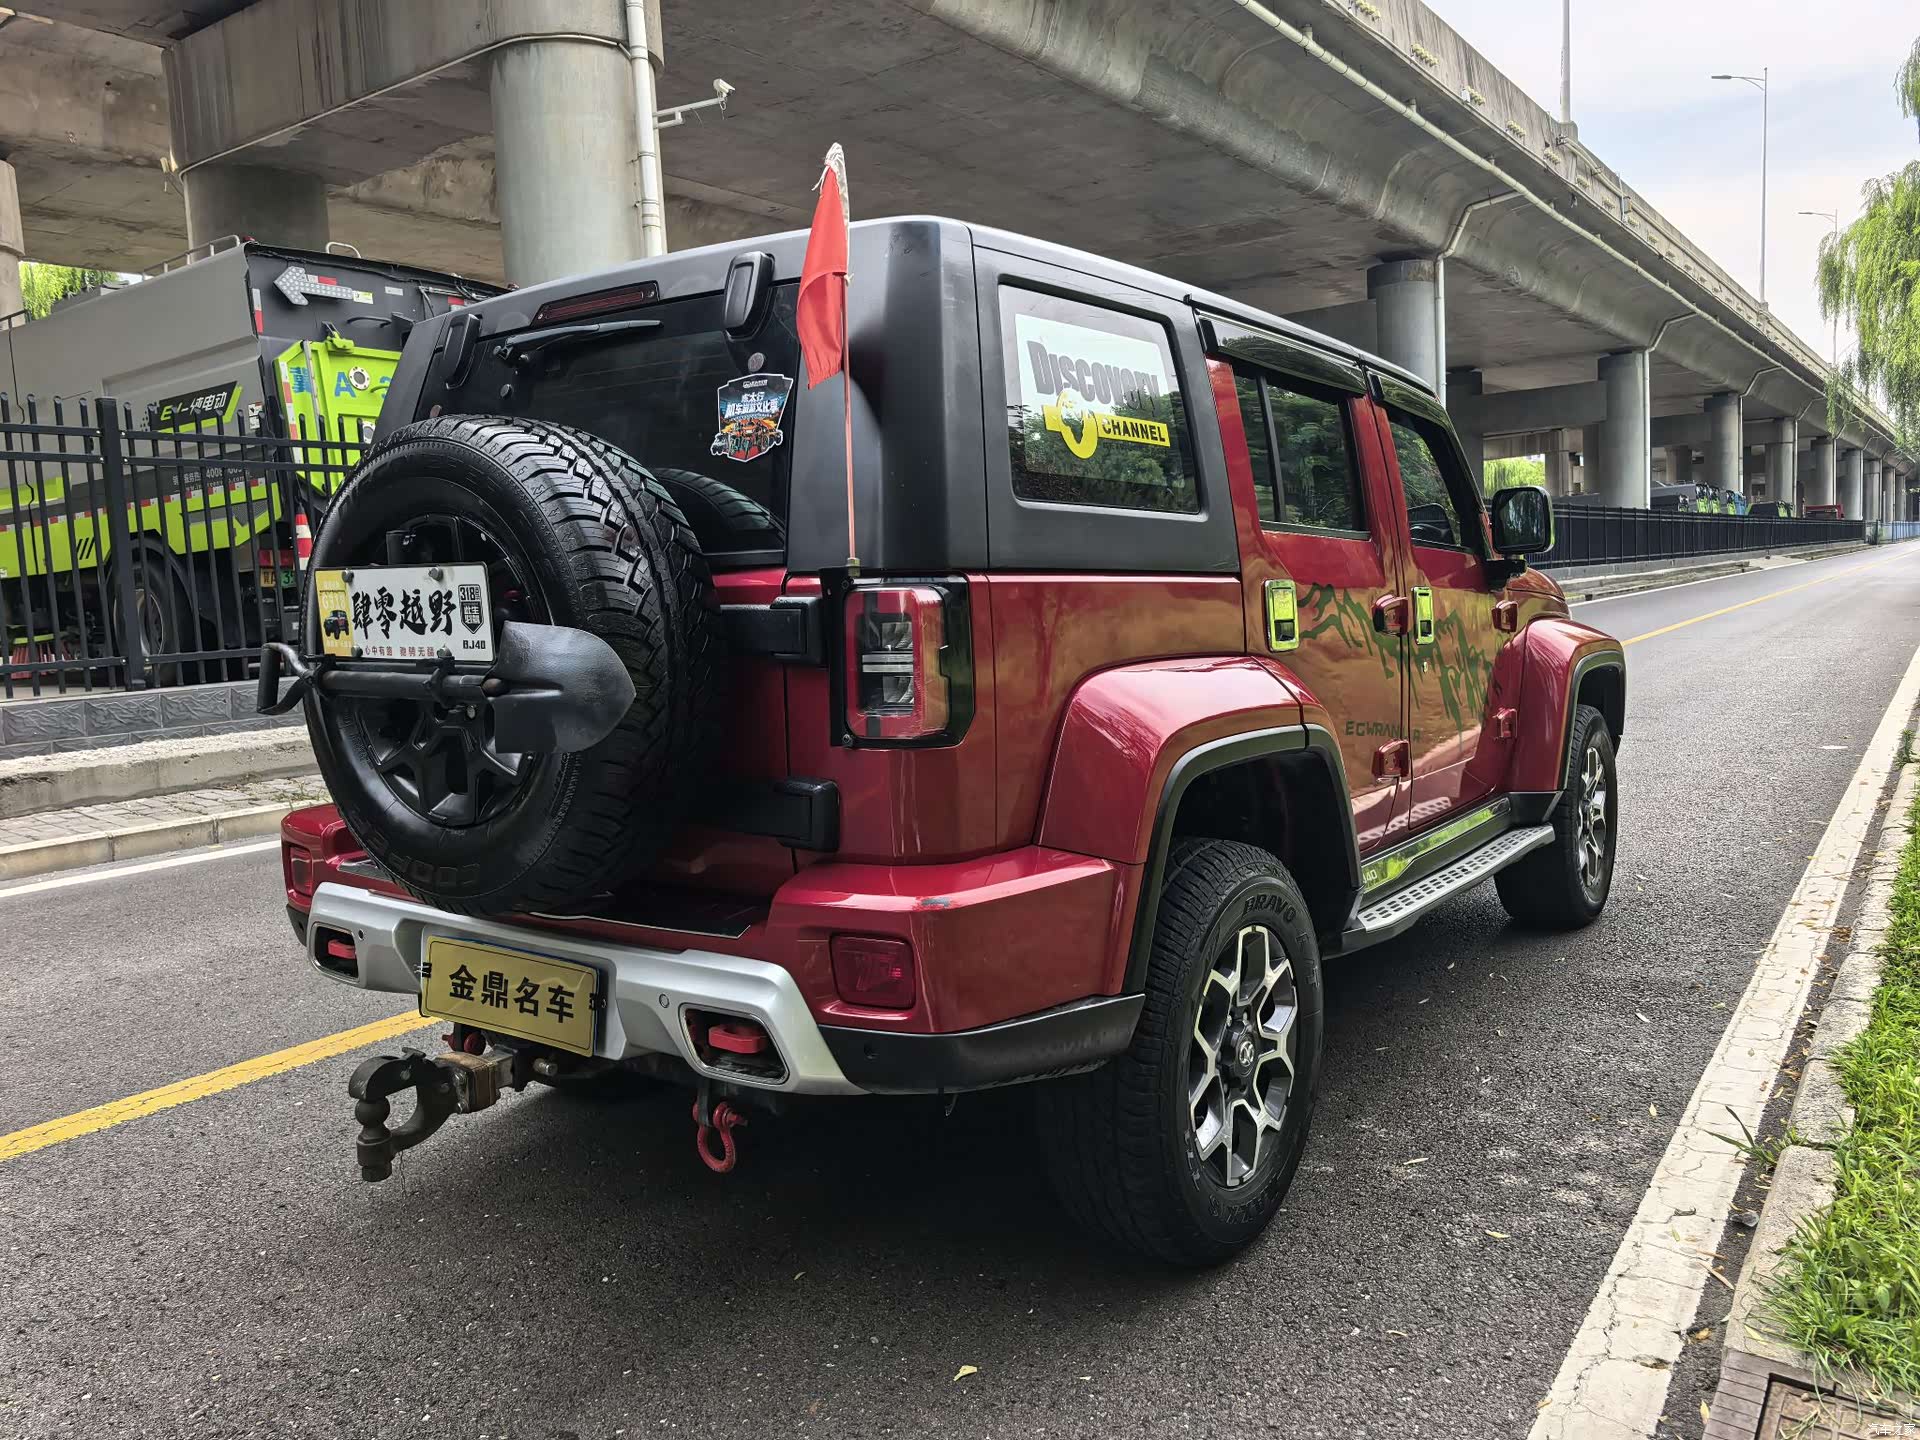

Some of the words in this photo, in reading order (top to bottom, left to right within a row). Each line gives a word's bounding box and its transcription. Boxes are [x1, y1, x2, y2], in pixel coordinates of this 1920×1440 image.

[1101, 418, 1166, 443] CHANNEL
[352, 586, 457, 640] 肆零越野
[462, 640, 486, 650] BJ40
[1241, 894, 1297, 922] BRAVO
[449, 964, 575, 1024] 金鼎名车
